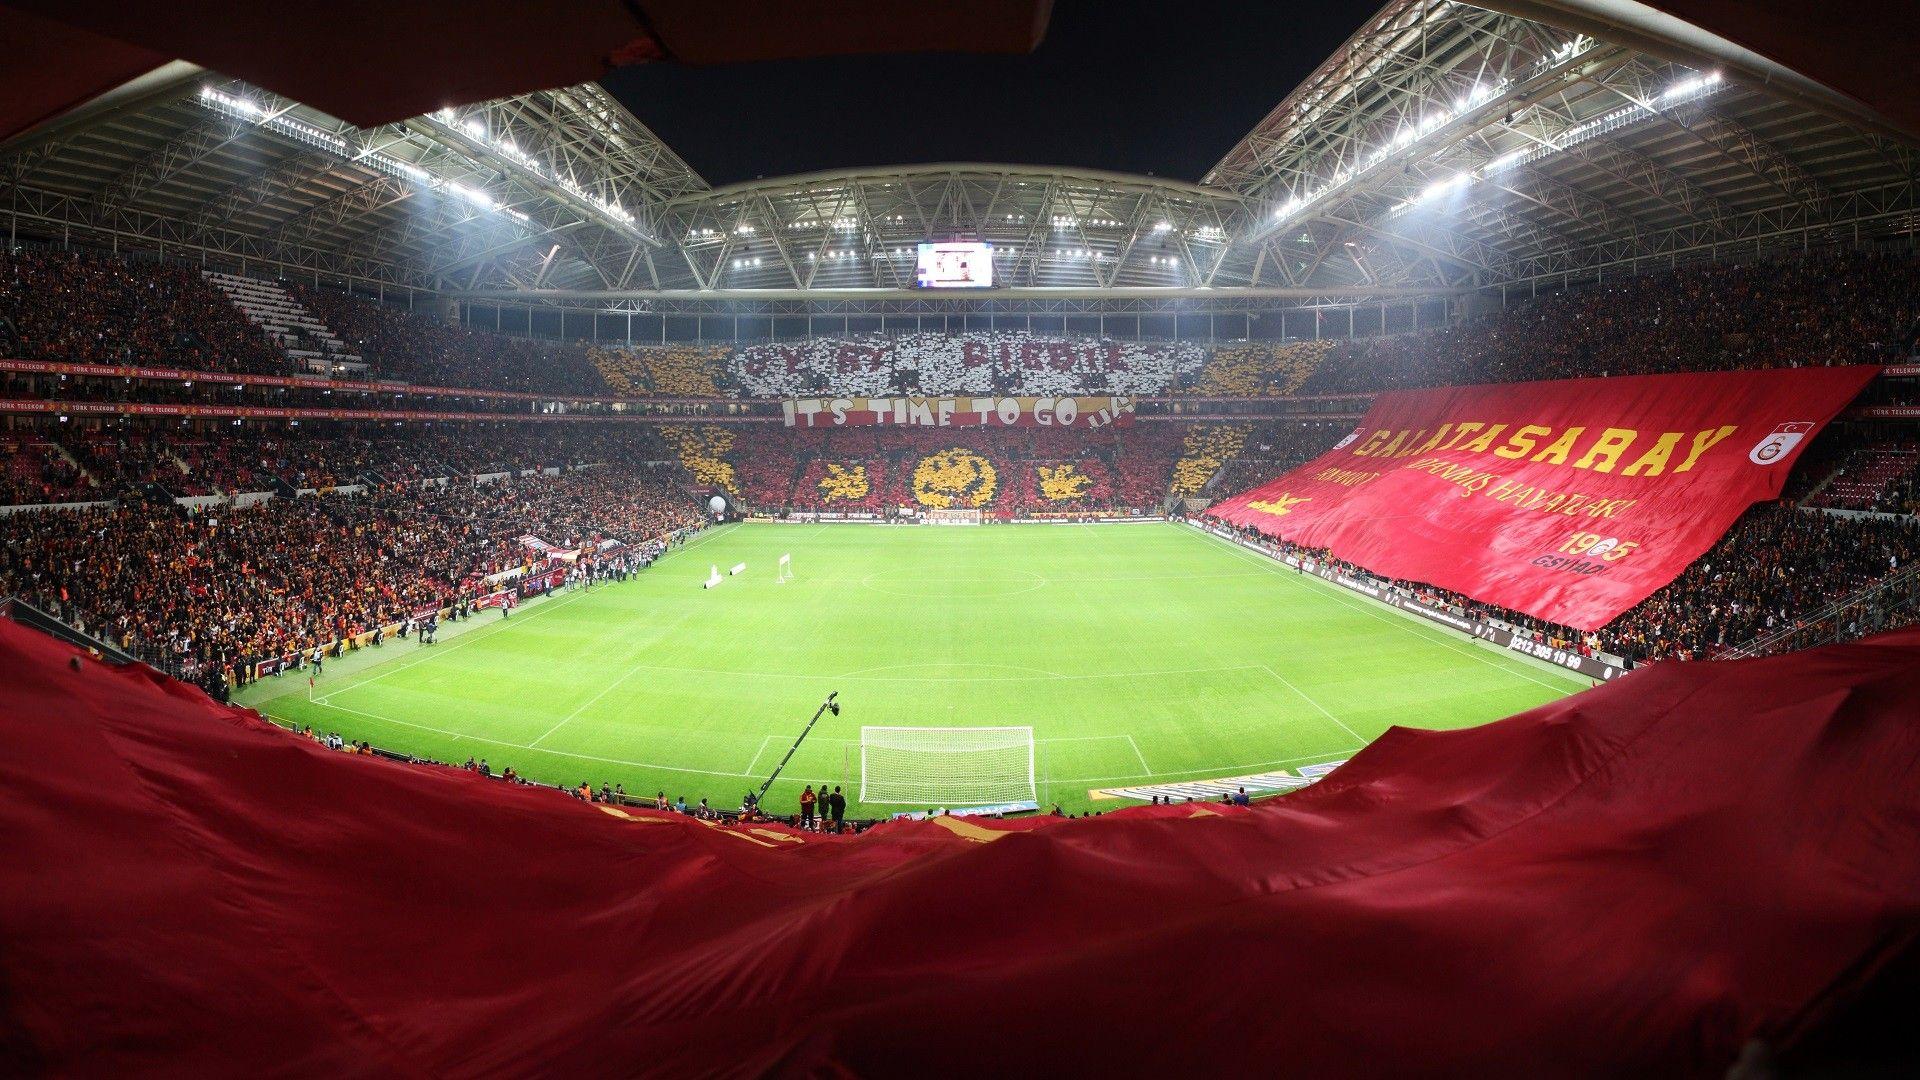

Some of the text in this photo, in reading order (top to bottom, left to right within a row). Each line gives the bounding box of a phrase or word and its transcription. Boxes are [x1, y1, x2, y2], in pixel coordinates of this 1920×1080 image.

[782, 397, 1079, 428] IT'S TIME TO GO
[1353, 422, 1738, 477] GALATASARAY
[1533, 644, 1553, 660] 305
[1553, 650, 1567, 664] 19
[1567, 654, 1582, 670] 99
